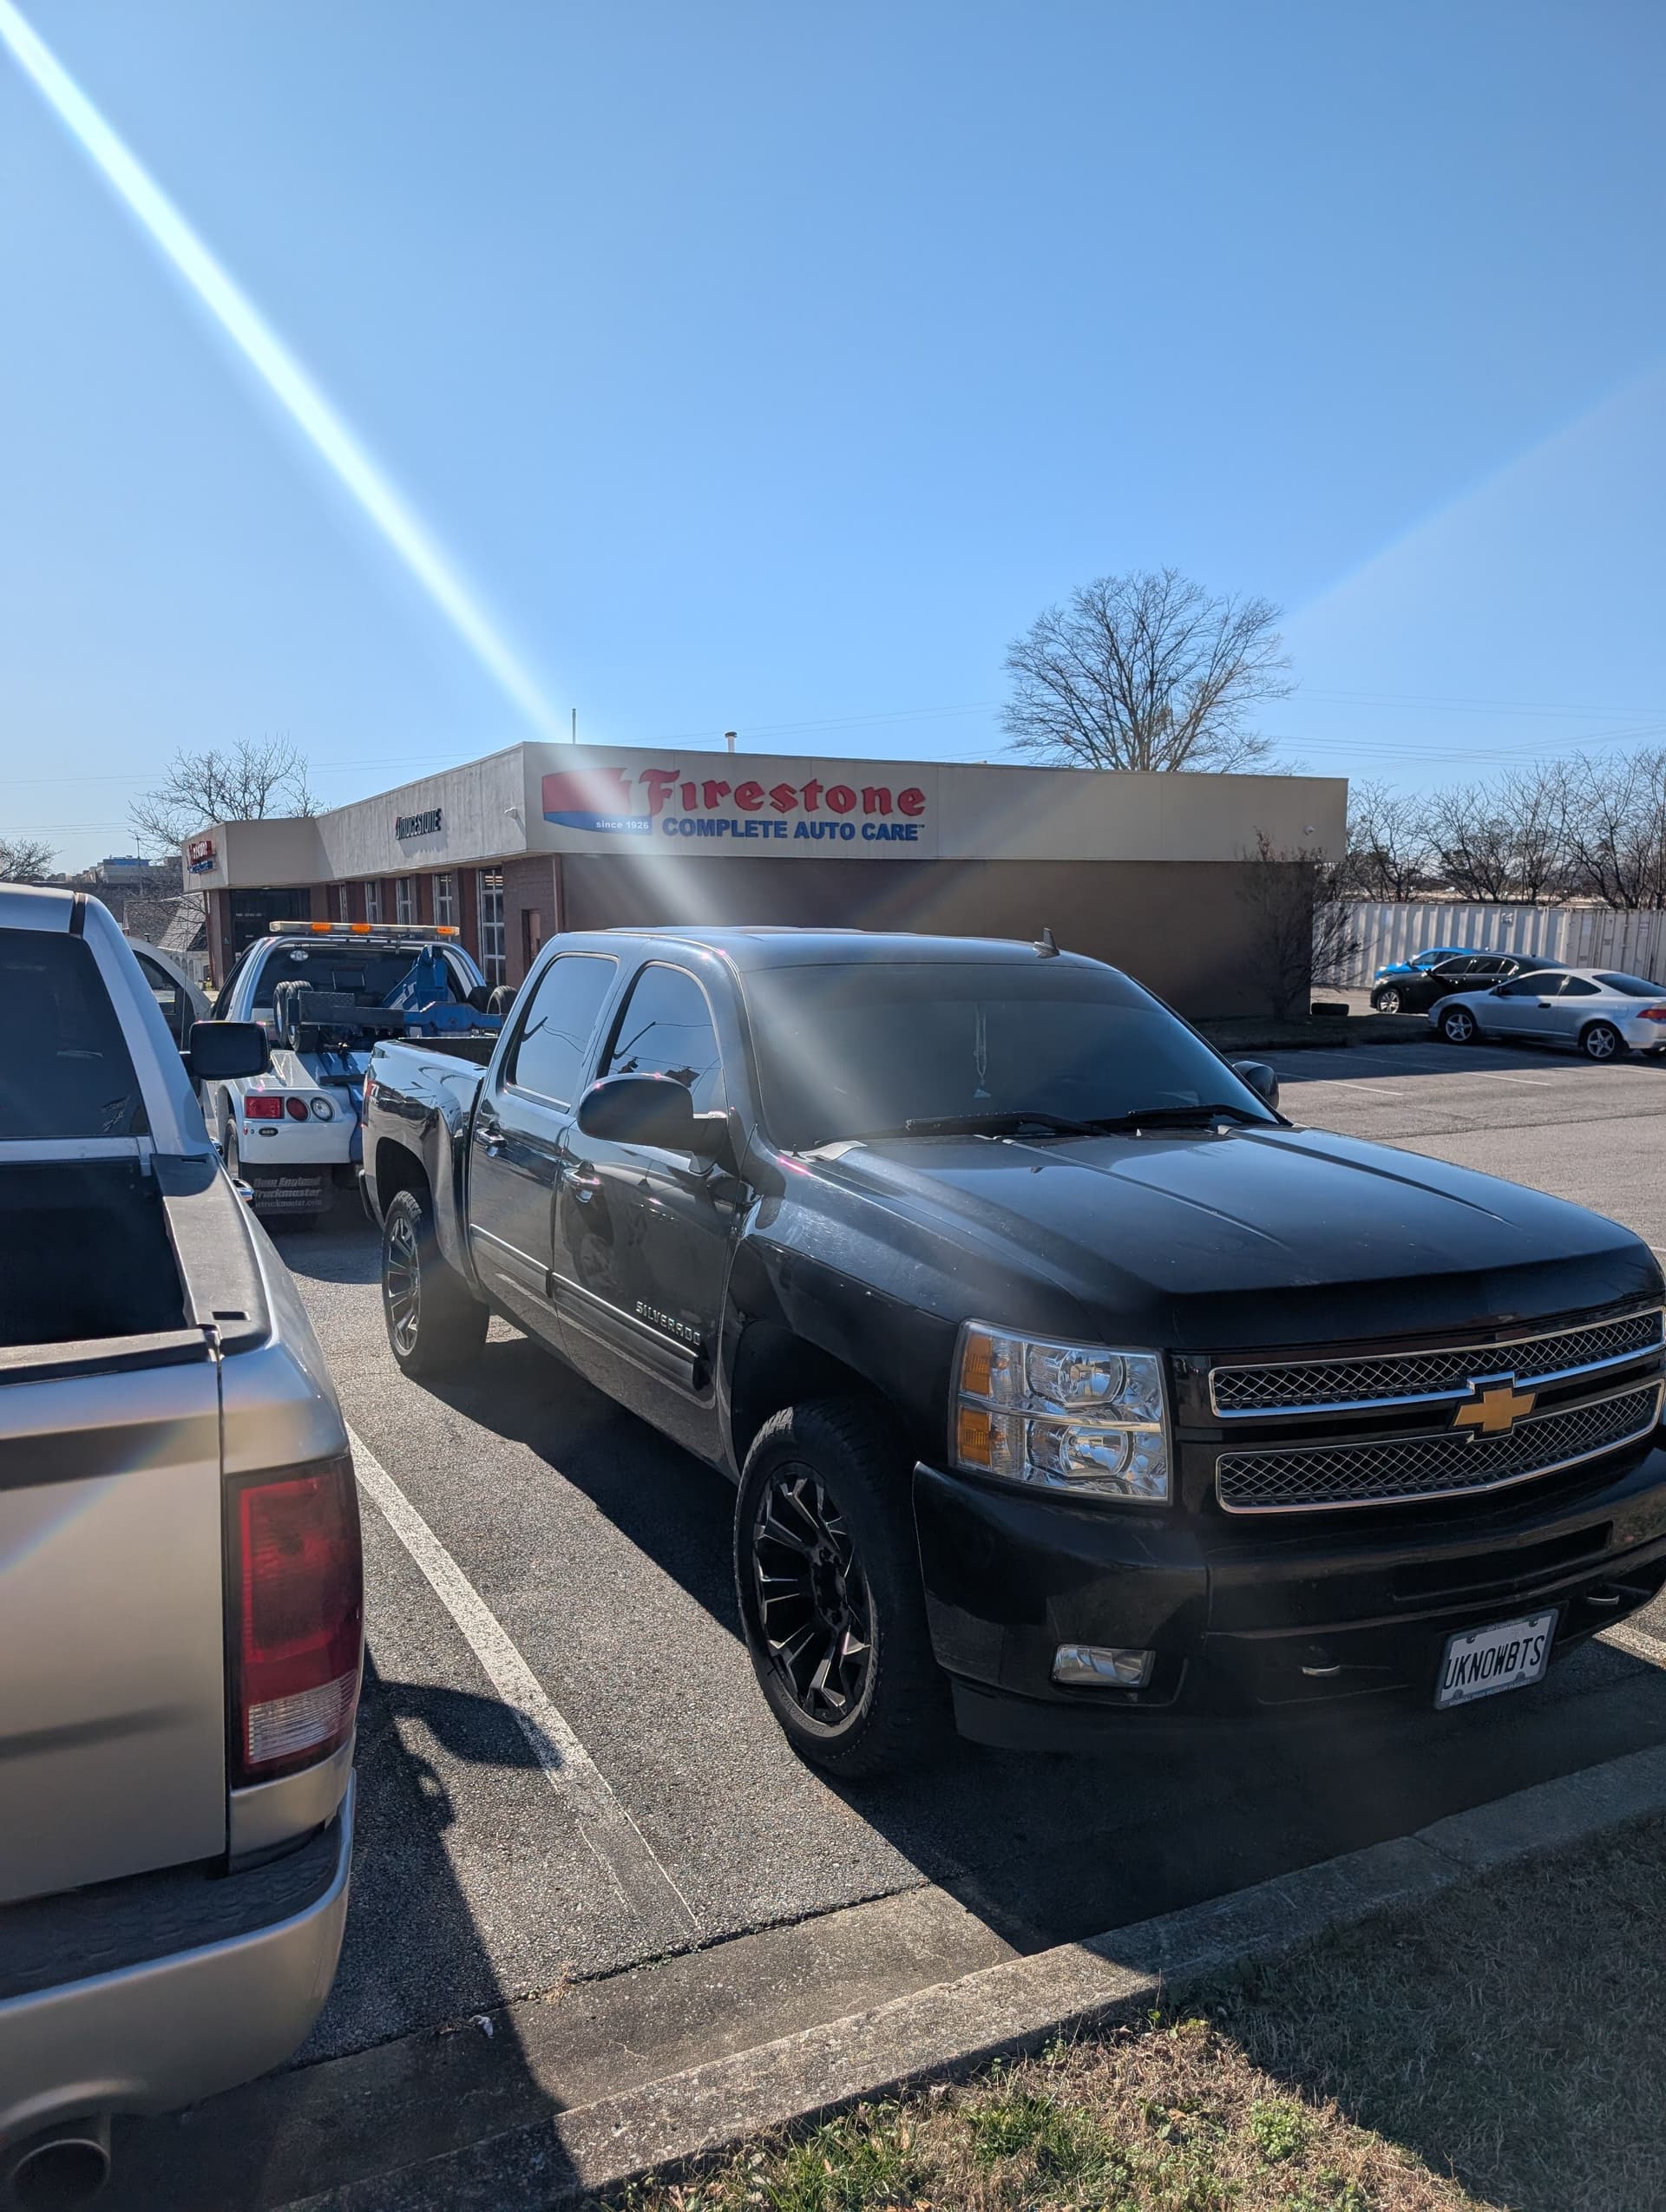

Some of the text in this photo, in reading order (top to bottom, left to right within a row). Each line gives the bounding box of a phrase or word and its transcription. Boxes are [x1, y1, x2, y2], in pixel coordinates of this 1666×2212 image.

[639, 769, 927, 816] Firestone
[596, 820, 650, 830] since 1926
[662, 817, 788, 839] COMPLETE
[794, 821, 856, 841] AUTO
[635, 1300, 701, 1346] SILVERADO
[1443, 1635, 1545, 1690] UKNOWBTS
